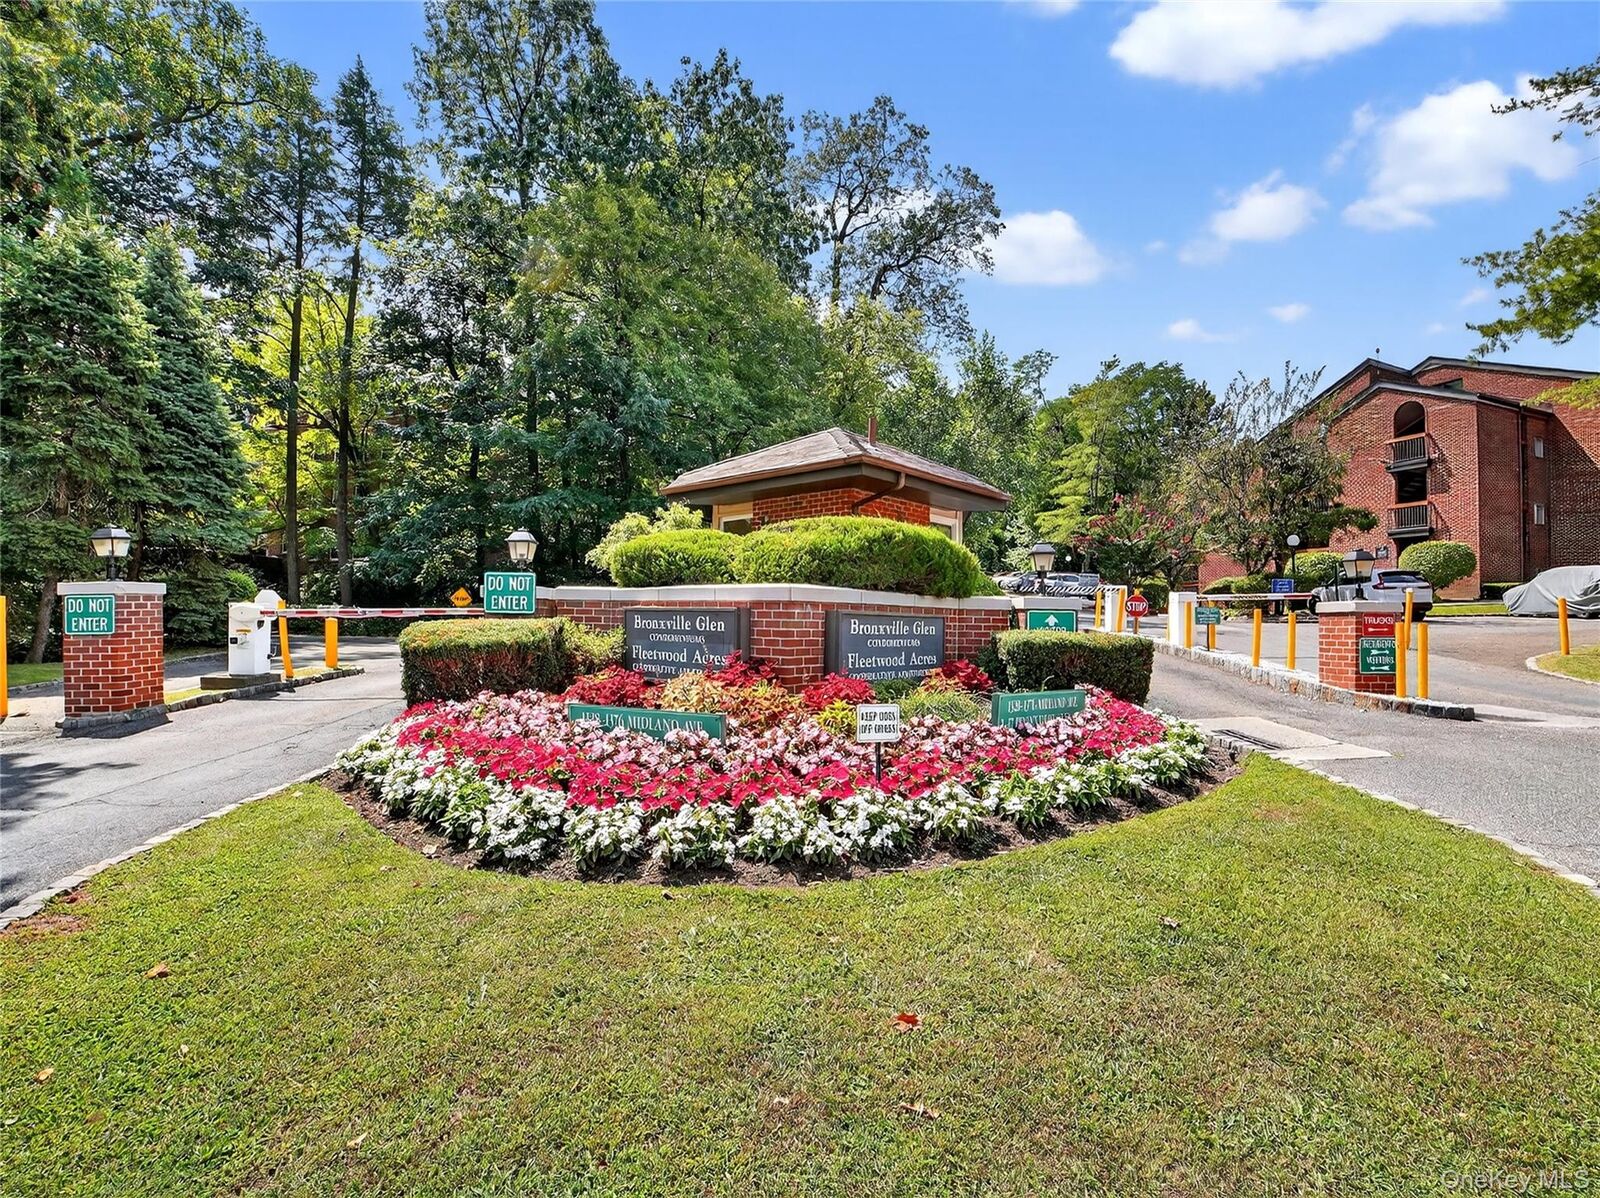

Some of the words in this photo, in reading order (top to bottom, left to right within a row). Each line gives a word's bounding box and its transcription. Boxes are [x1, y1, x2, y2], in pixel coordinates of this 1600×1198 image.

[487, 576, 503, 591] DO
[509, 577, 531, 591] NOT
[68, 598, 83, 613] DO
[89, 598, 110, 613] NOT
[491, 596, 528, 610] ENTER
[1127, 601, 1145, 612] STOP
[72, 617, 108, 632] ENTER
[634, 615, 691, 630] Bronxville
[696, 616, 725, 632] Glen
[850, 618, 909, 635] Bronxville
[913, 620, 936, 635] Glen
[632, 645, 687, 663] Fleetwood
[692, 649, 727, 666] Acres
[848, 652, 905, 669] Fleetwood
[909, 652, 937, 666] Acres
